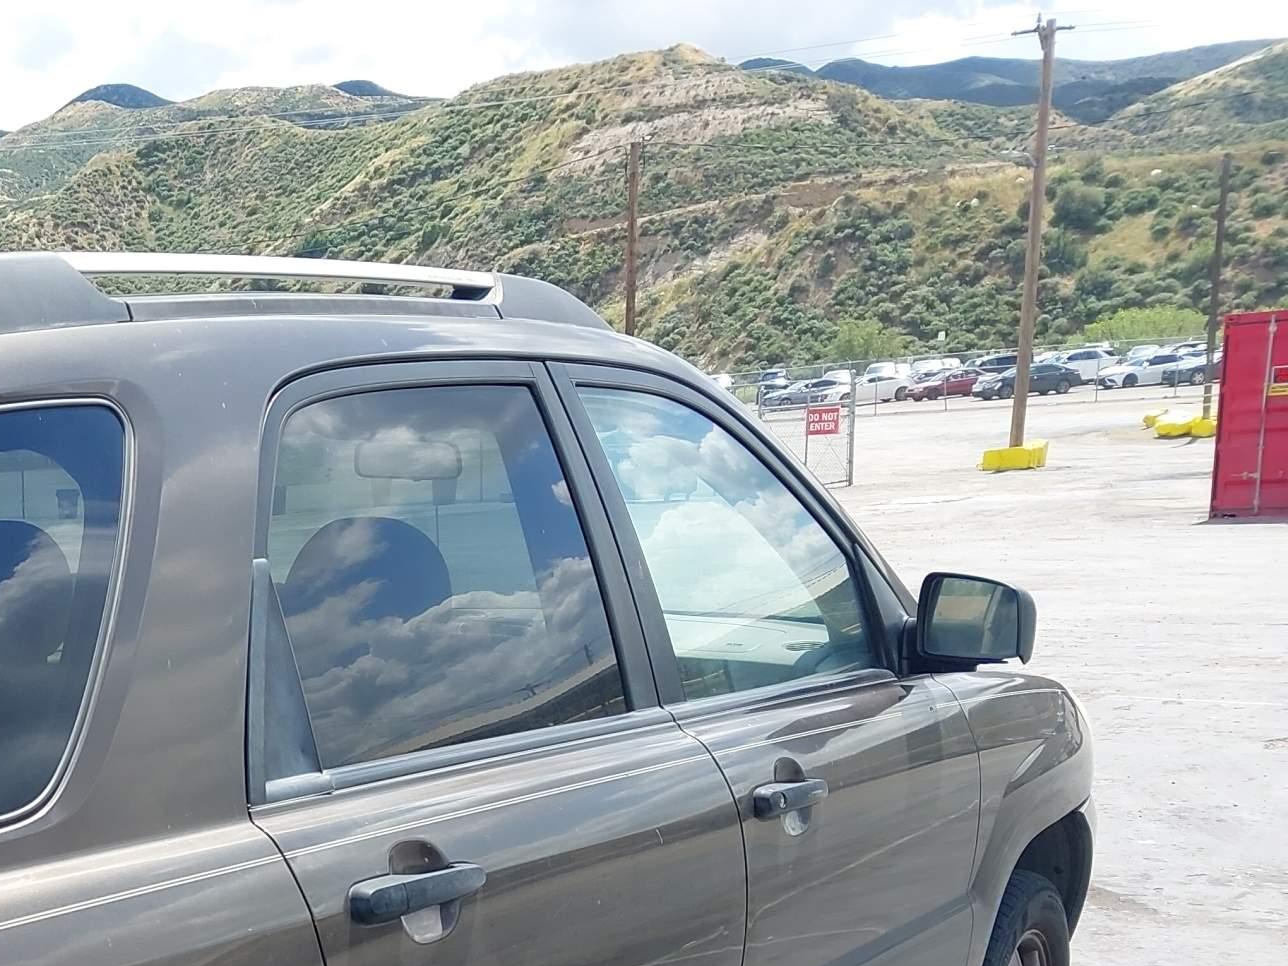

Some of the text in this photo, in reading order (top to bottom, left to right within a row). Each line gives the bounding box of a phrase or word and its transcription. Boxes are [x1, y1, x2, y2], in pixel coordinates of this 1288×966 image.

[808, 412, 838, 422] DO NOT
[809, 422, 836, 431] ENTER
